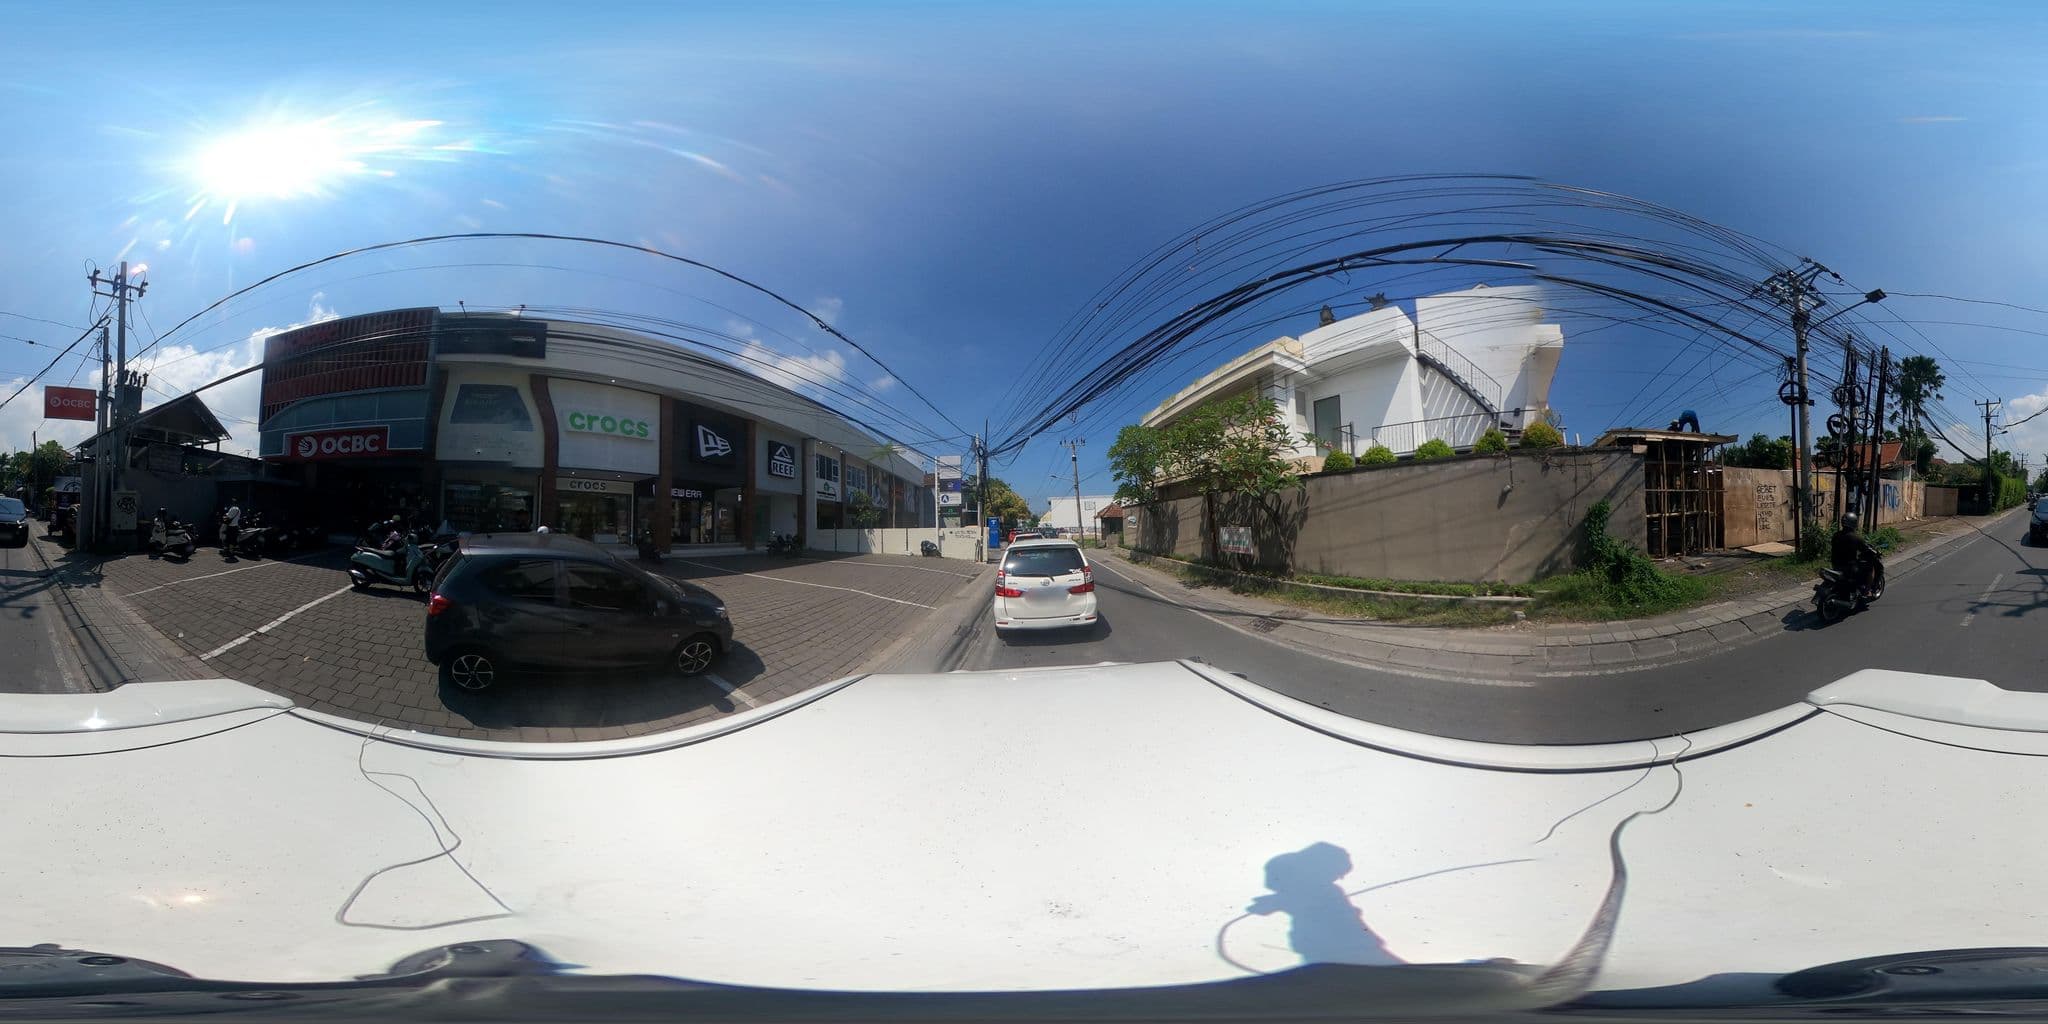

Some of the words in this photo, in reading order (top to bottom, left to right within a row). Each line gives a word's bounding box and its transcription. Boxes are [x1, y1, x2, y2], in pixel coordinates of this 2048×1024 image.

[62, 398, 90, 408] OCBC
[568, 411, 649, 438] crocs
[321, 434, 380, 454] OCBC
[772, 462, 794, 476] REEF
[569, 480, 607, 491] crocs
[685, 489, 702, 498] ERA
